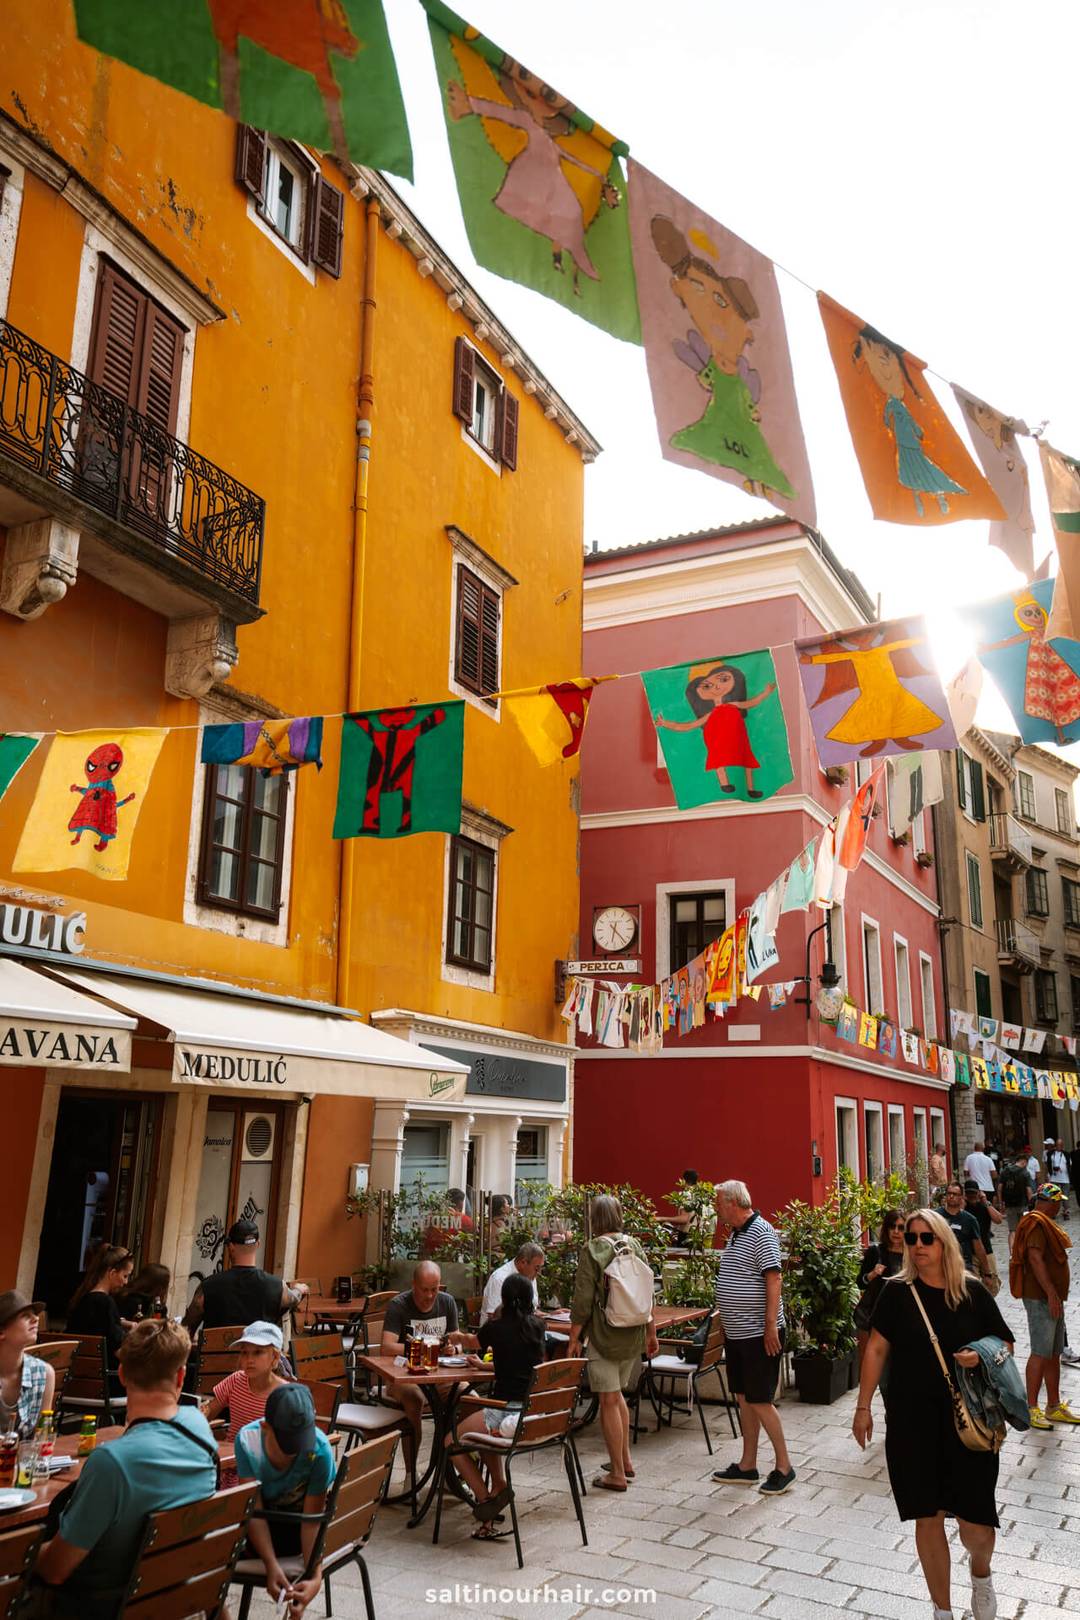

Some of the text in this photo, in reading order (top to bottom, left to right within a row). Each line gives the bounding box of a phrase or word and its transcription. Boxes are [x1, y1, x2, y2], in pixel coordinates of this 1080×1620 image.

[723, 438, 749, 458] LOL
[580, 962, 625, 972] PERICA
[0, 1027, 120, 1064] AVANA
[181, 1054, 287, 1085] MEDULIĆ
